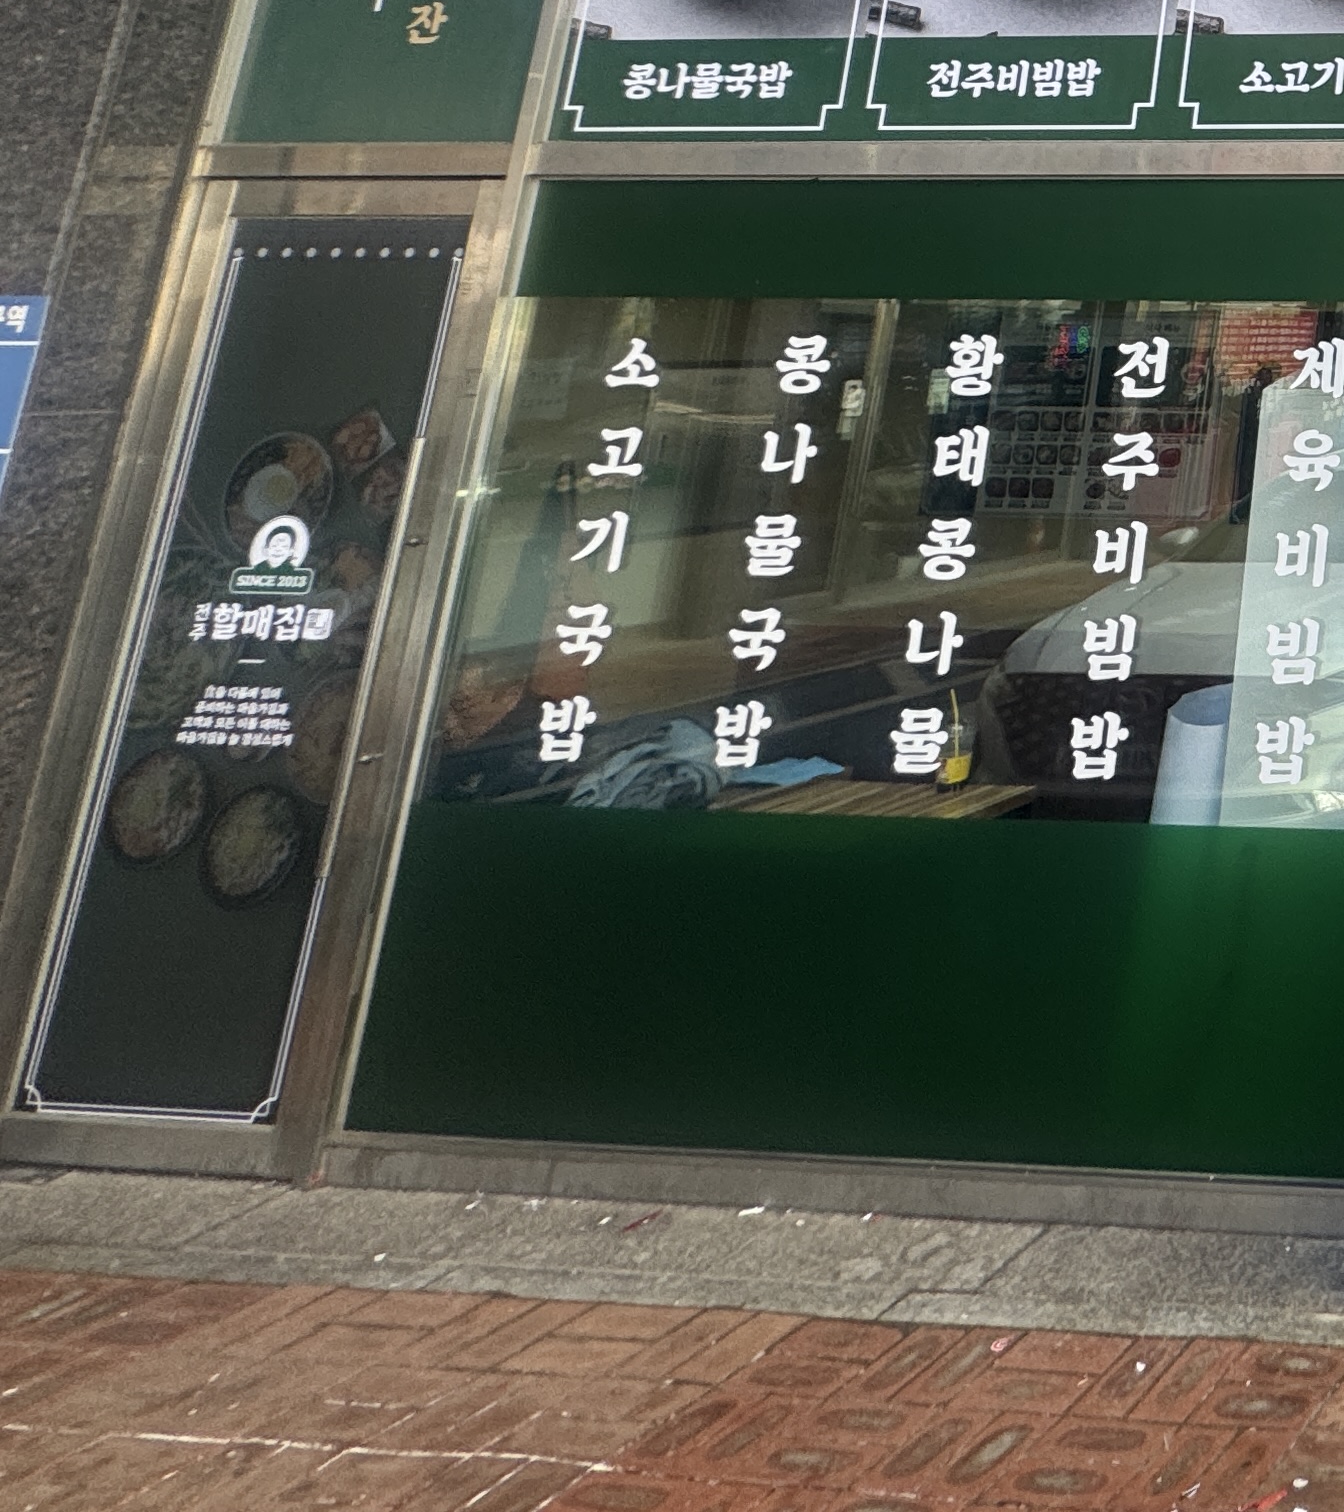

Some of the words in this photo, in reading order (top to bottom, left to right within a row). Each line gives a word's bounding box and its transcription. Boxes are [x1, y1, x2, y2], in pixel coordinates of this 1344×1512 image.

[622, 60, 793, 102] 콩나물국밥
[925, 58, 1101, 100] 전주비빔밥
[211, 603, 305, 641] 할매집
[539, 338, 661, 763] 소고기국밥
[714, 334, 831, 768] 콩나물국밥
[891, 334, 1004, 774] 황태콩나물
[1070, 336, 1170, 780] 전주비빔밥
